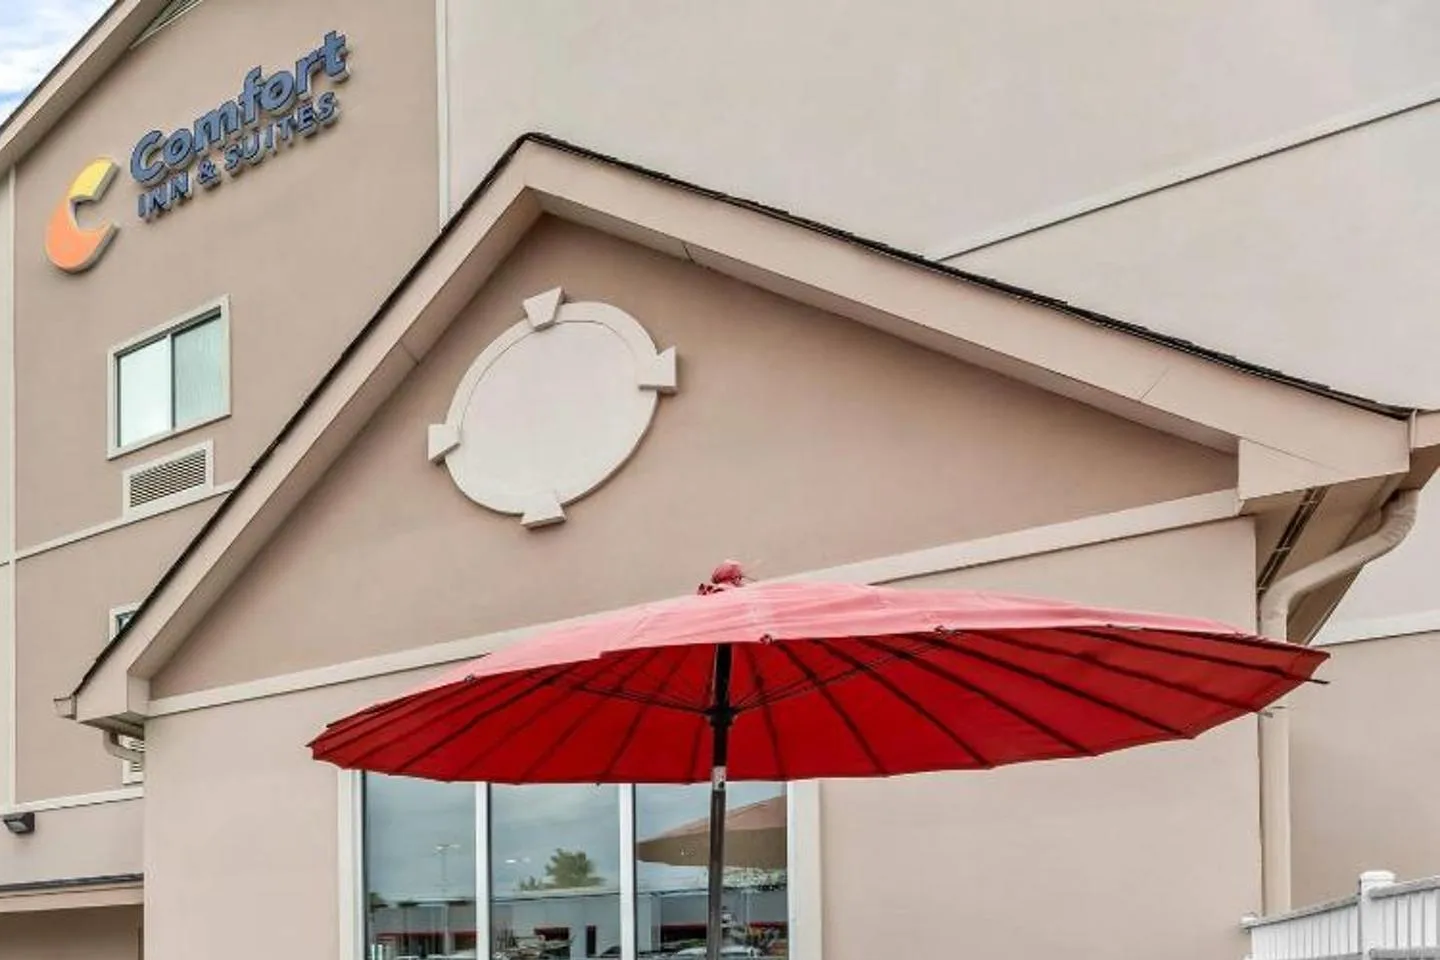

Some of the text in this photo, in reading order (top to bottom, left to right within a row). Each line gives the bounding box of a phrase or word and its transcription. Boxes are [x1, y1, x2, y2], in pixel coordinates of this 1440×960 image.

[129, 30, 349, 185] Comfort
[137, 91, 339, 222] INN & SUITES
